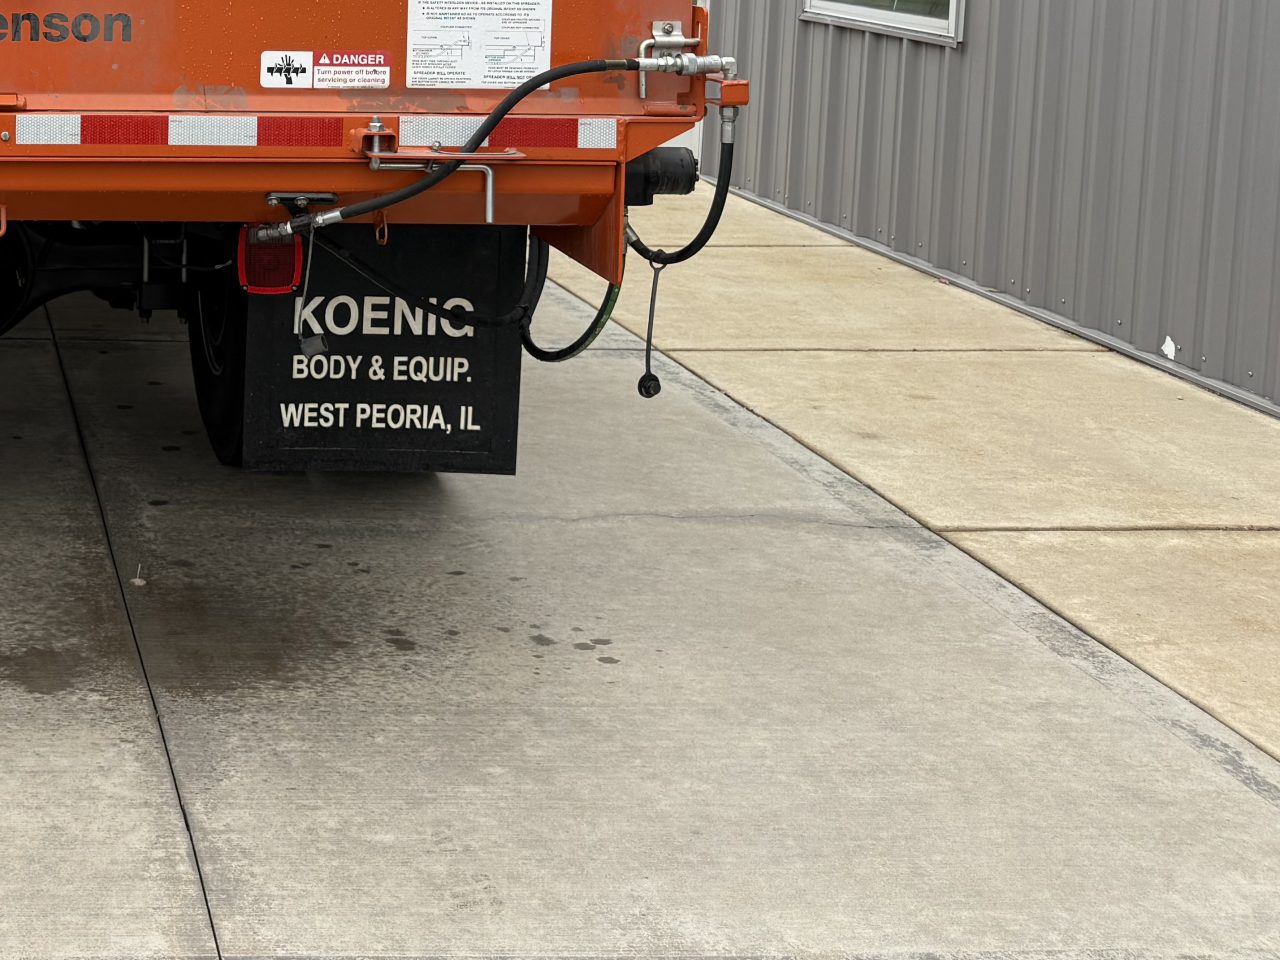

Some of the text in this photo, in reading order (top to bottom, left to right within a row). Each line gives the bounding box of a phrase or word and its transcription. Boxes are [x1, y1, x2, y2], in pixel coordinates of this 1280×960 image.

[332, 54, 385, 65] DANGER
[317, 76, 347, 84] servicing
[357, 76, 386, 84] cleaning
[333, 69, 353, 77] power
[293, 295, 475, 337] KOENIG
[292, 354, 472, 383] BODY & EQUIP.
[280, 403, 481, 434] WEST PEORIA, IL
